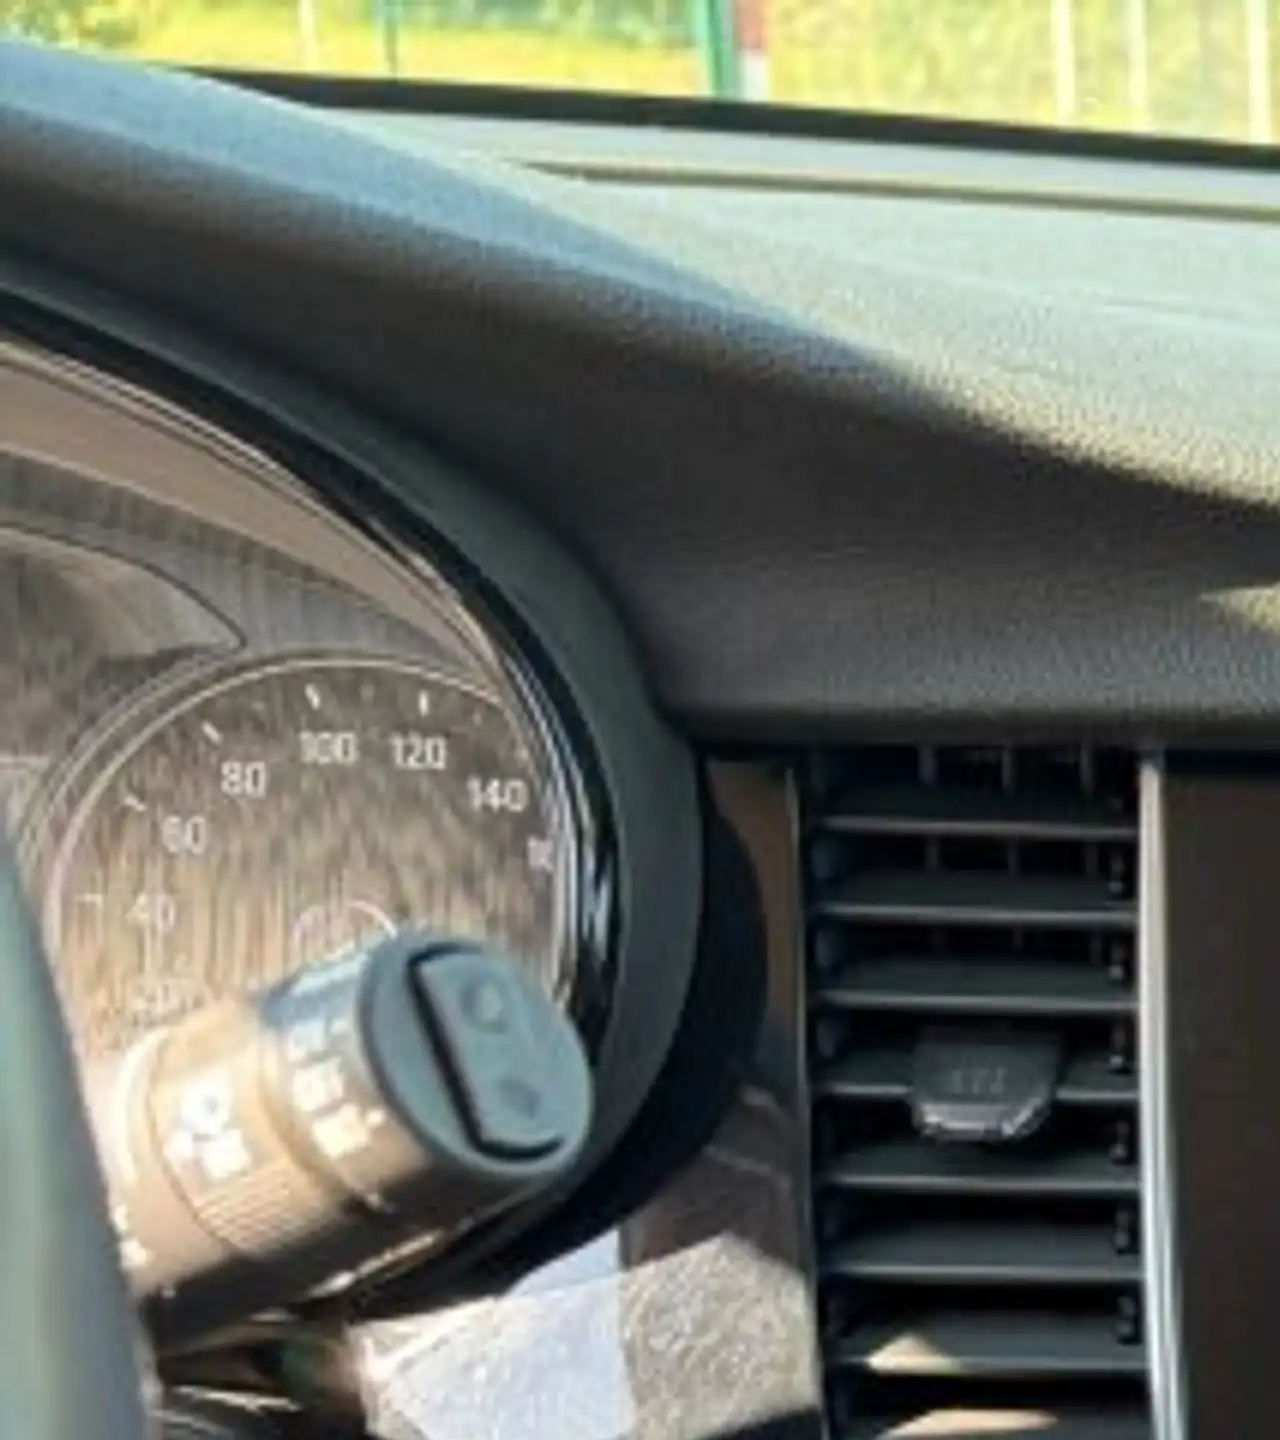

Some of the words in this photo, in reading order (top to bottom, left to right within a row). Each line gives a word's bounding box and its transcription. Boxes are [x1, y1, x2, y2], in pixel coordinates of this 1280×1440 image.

[391, 730, 447, 770] 120
[220, 760, 266, 798] 80
[466, 776, 530, 813] 140
